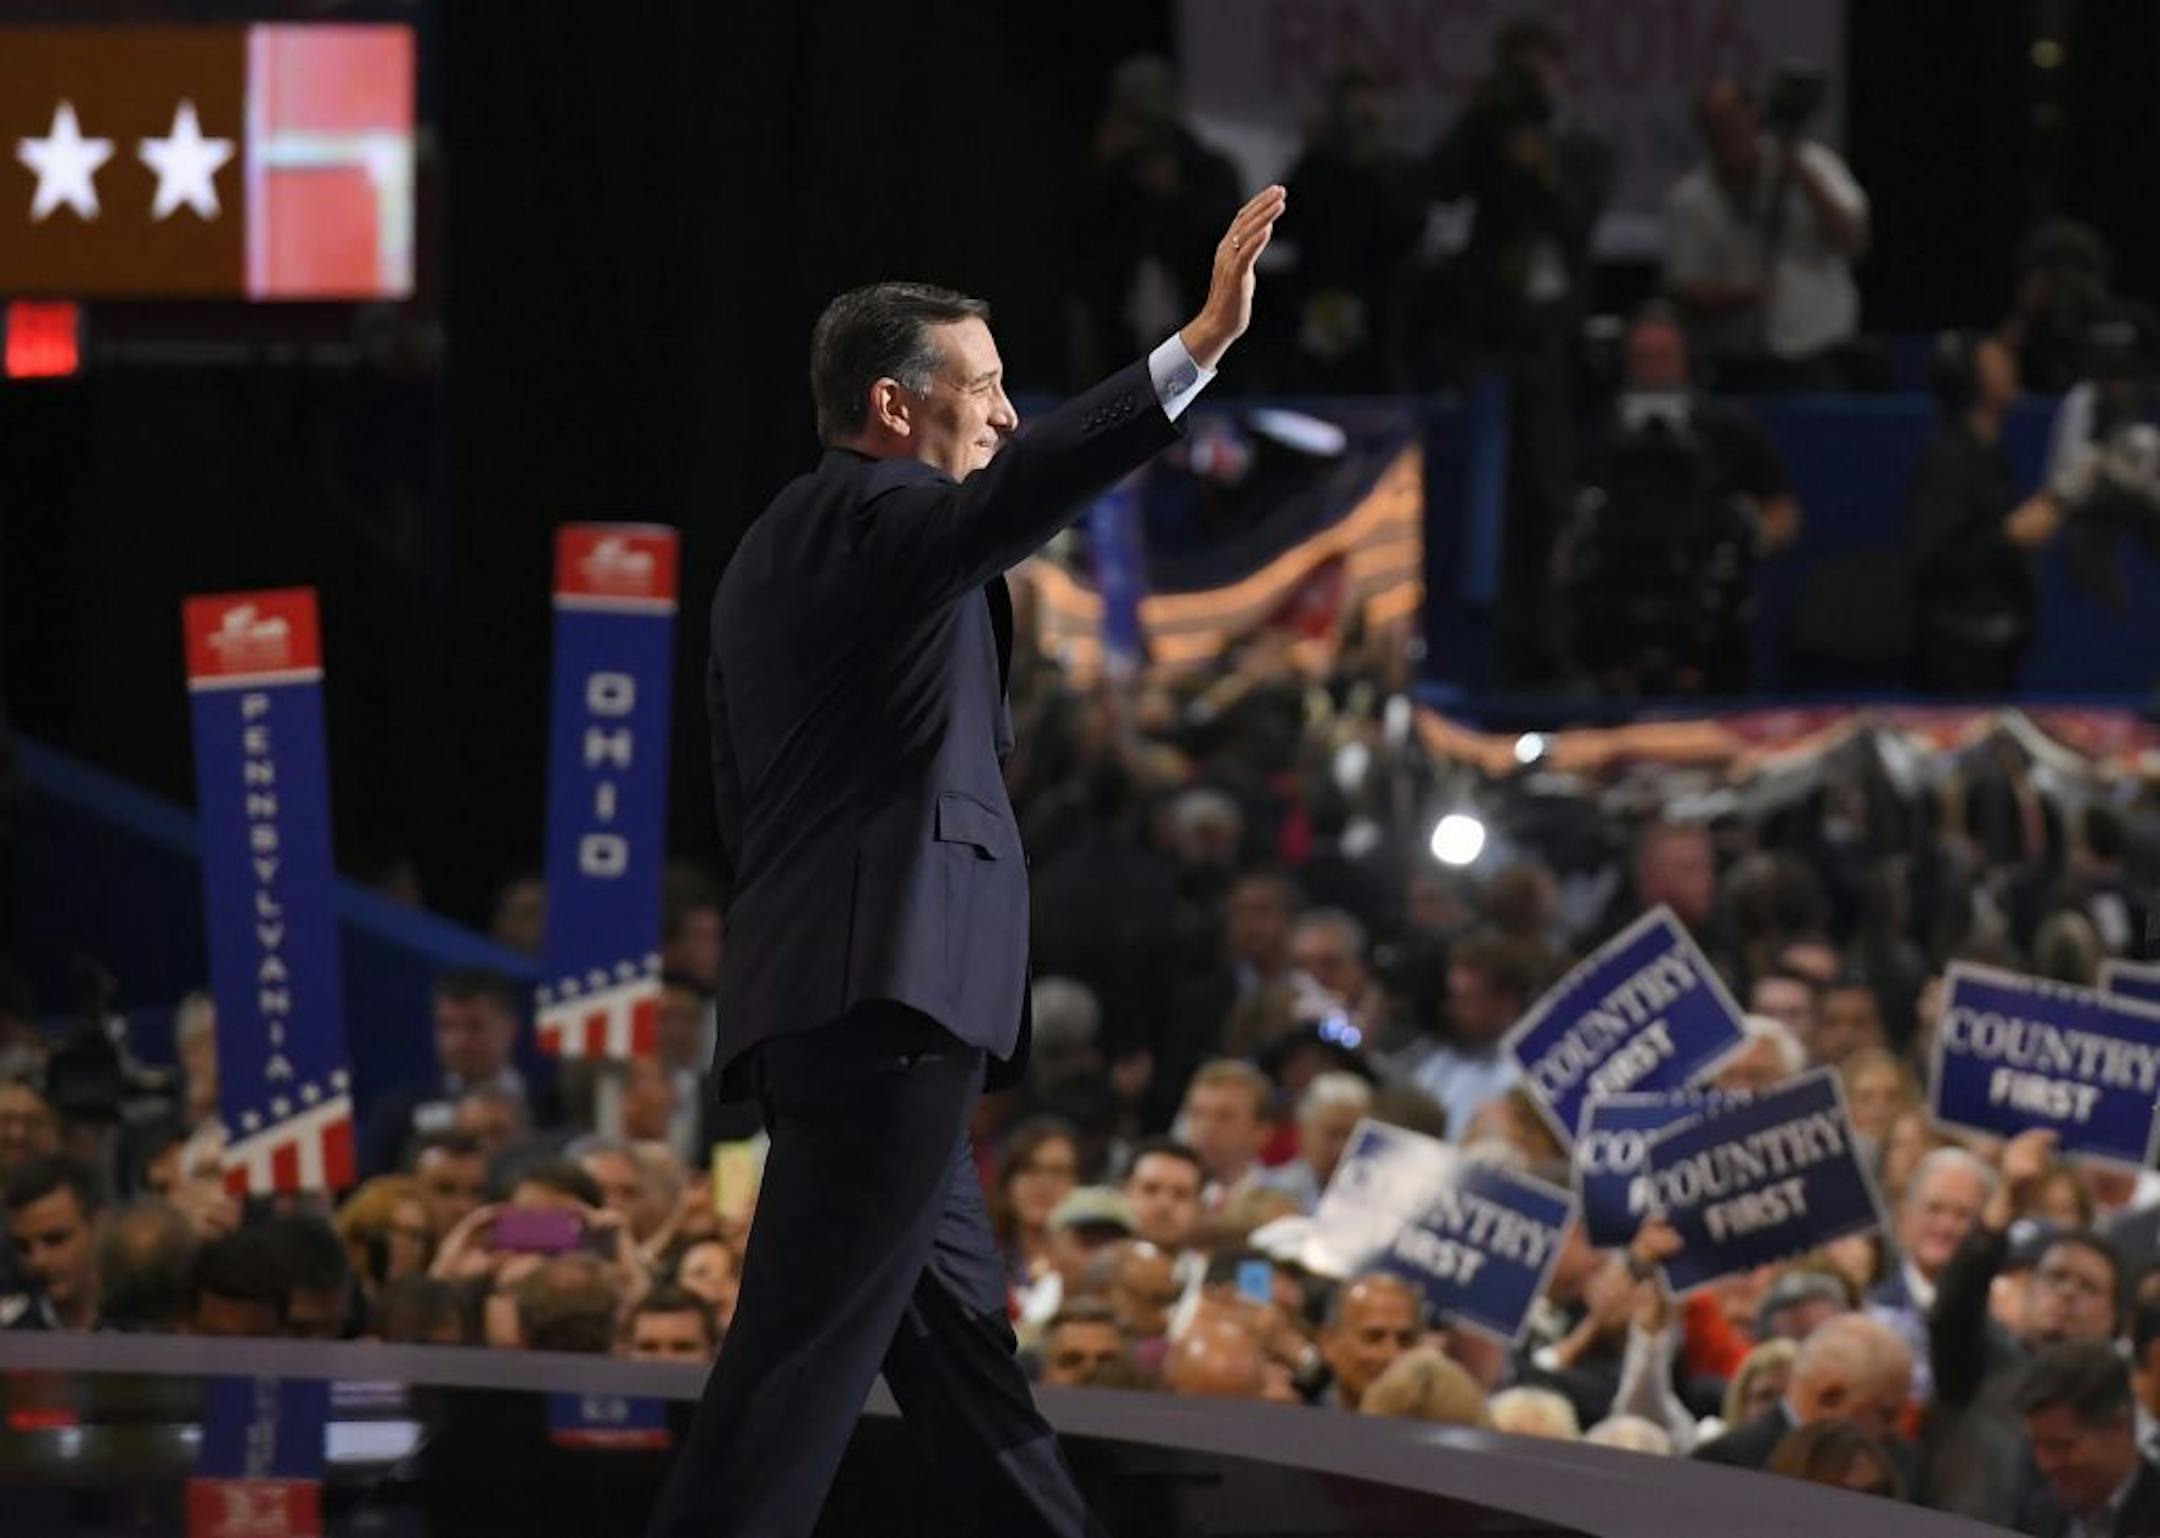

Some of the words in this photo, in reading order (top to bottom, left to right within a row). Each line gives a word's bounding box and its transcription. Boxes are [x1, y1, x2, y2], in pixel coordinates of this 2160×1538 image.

[579, 671, 637, 878] OHIO
[242, 693, 295, 1084] PENNSYLVANIA
[1528, 943, 1698, 1102] COUNTRY
[1587, 1018, 1676, 1099] FIRST
[1989, 1066, 2101, 1124] FIRST
[1652, 1108, 1846, 1216] COUNTRY
[1704, 1177, 1806, 1243] FIRST
